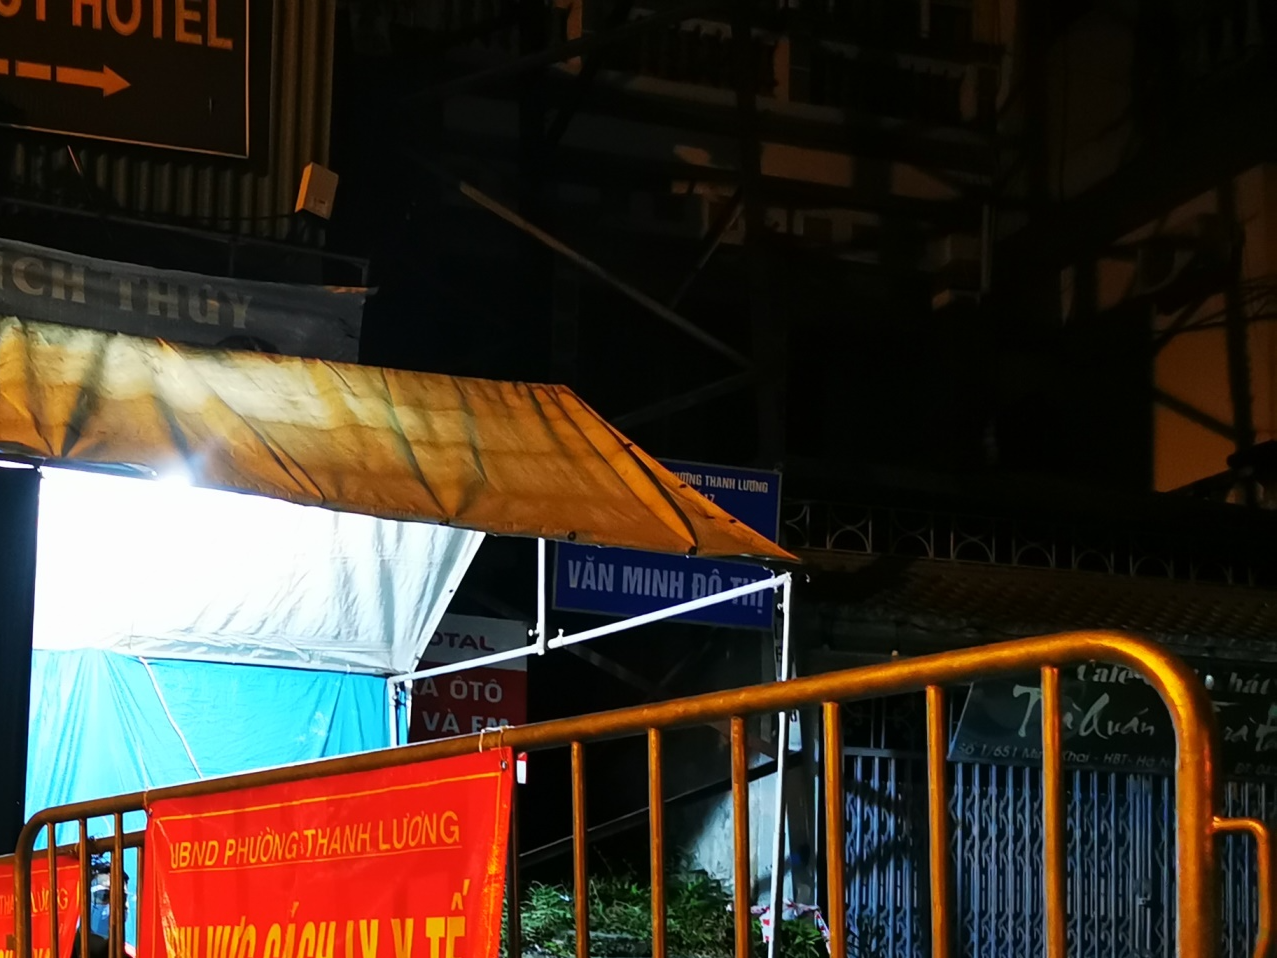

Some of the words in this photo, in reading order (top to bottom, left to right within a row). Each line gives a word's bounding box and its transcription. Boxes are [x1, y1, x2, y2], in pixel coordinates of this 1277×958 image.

[72, 0, 233, 50] HOTEL
[705, 474, 736, 491] THANH
[568, 554, 615, 593] VĂN
[622, 565, 685, 600] MINH
[691, 568, 723, 601] ĐÔ
[429, 631, 495, 652] OTAL
[422, 708, 461, 734] VÀ
[169, 840, 220, 869] UBND
[223, 826, 299, 866] PHƯỜNG
[302, 821, 372, 858] THANH
[379, 811, 460, 851] LƯƠNG
